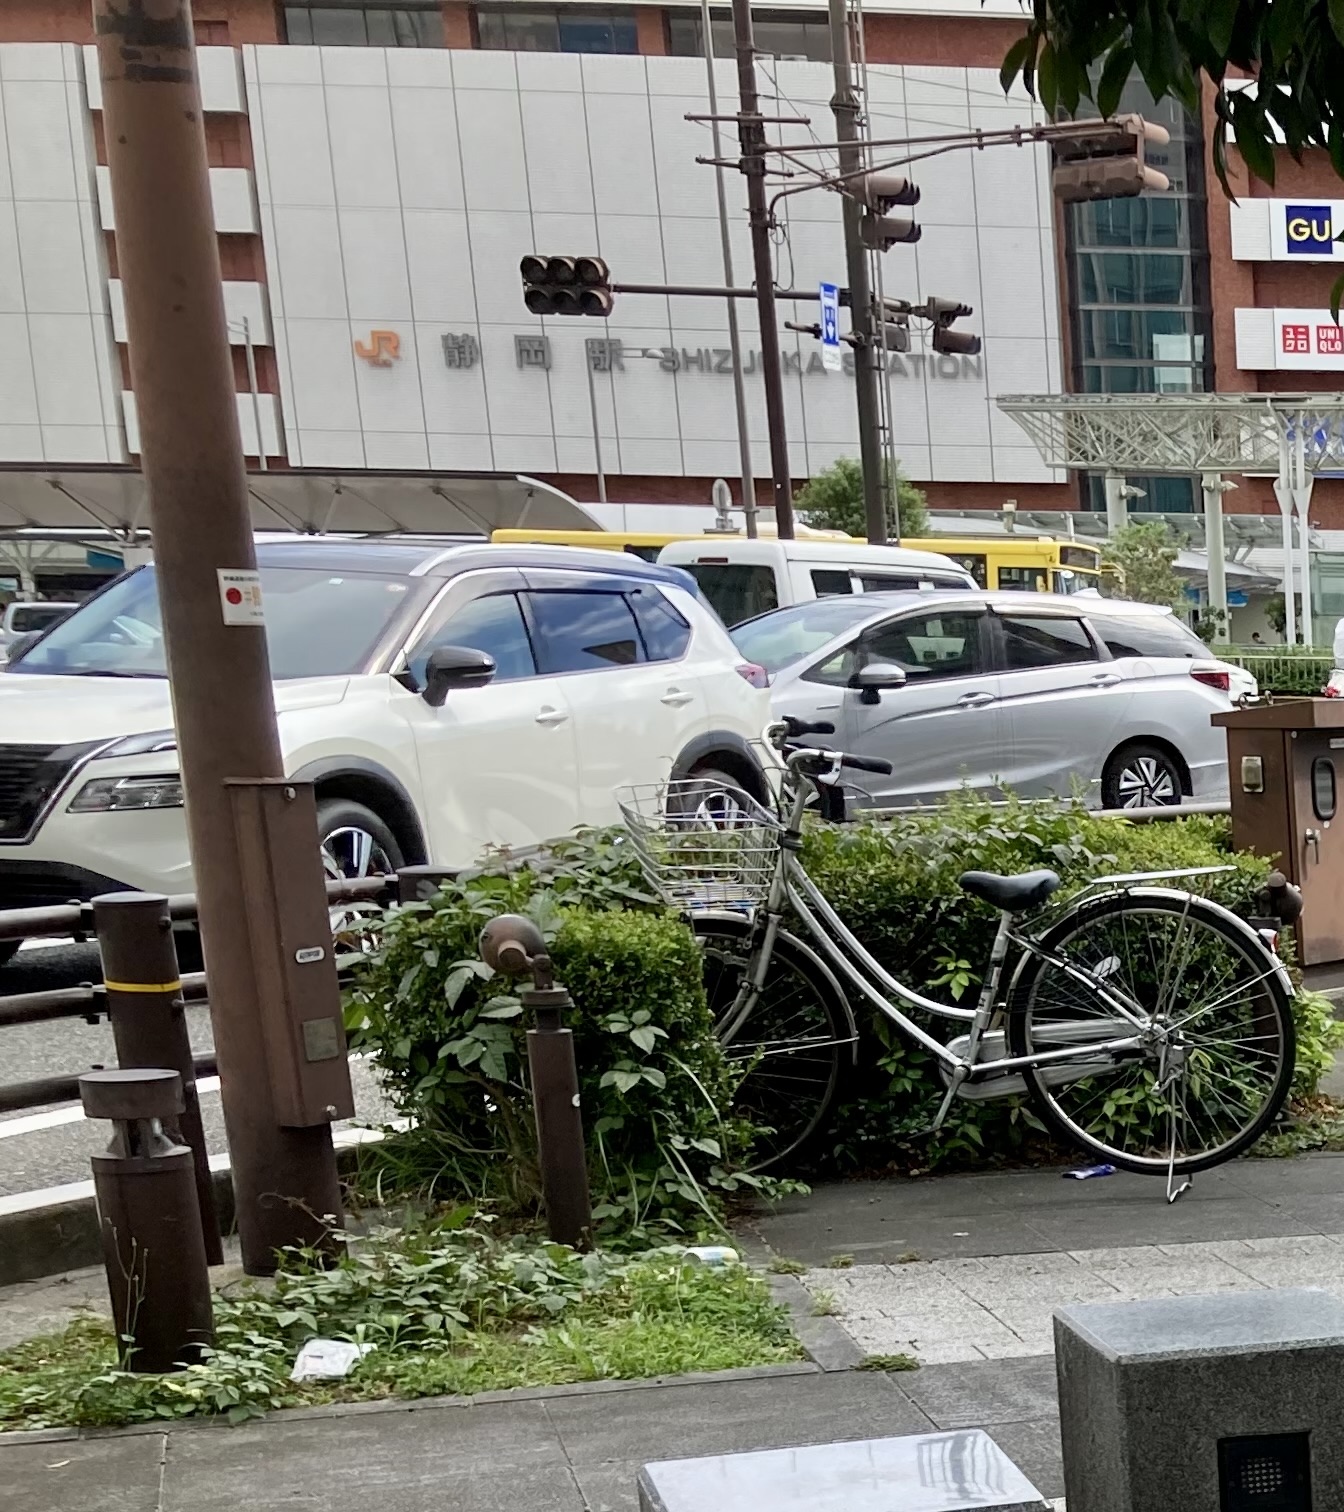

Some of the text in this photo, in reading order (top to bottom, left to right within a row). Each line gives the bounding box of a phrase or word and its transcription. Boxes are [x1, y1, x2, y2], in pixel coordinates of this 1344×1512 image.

[1289, 218, 1330, 242] GU
[1318, 328, 1340, 340] UNI
[1319, 340, 1342, 352] QLO
[354, 330, 626, 372] JR 静岡駅
[659, 347, 829, 376] SHIZUKA
[842, 351, 983, 380] SATION
